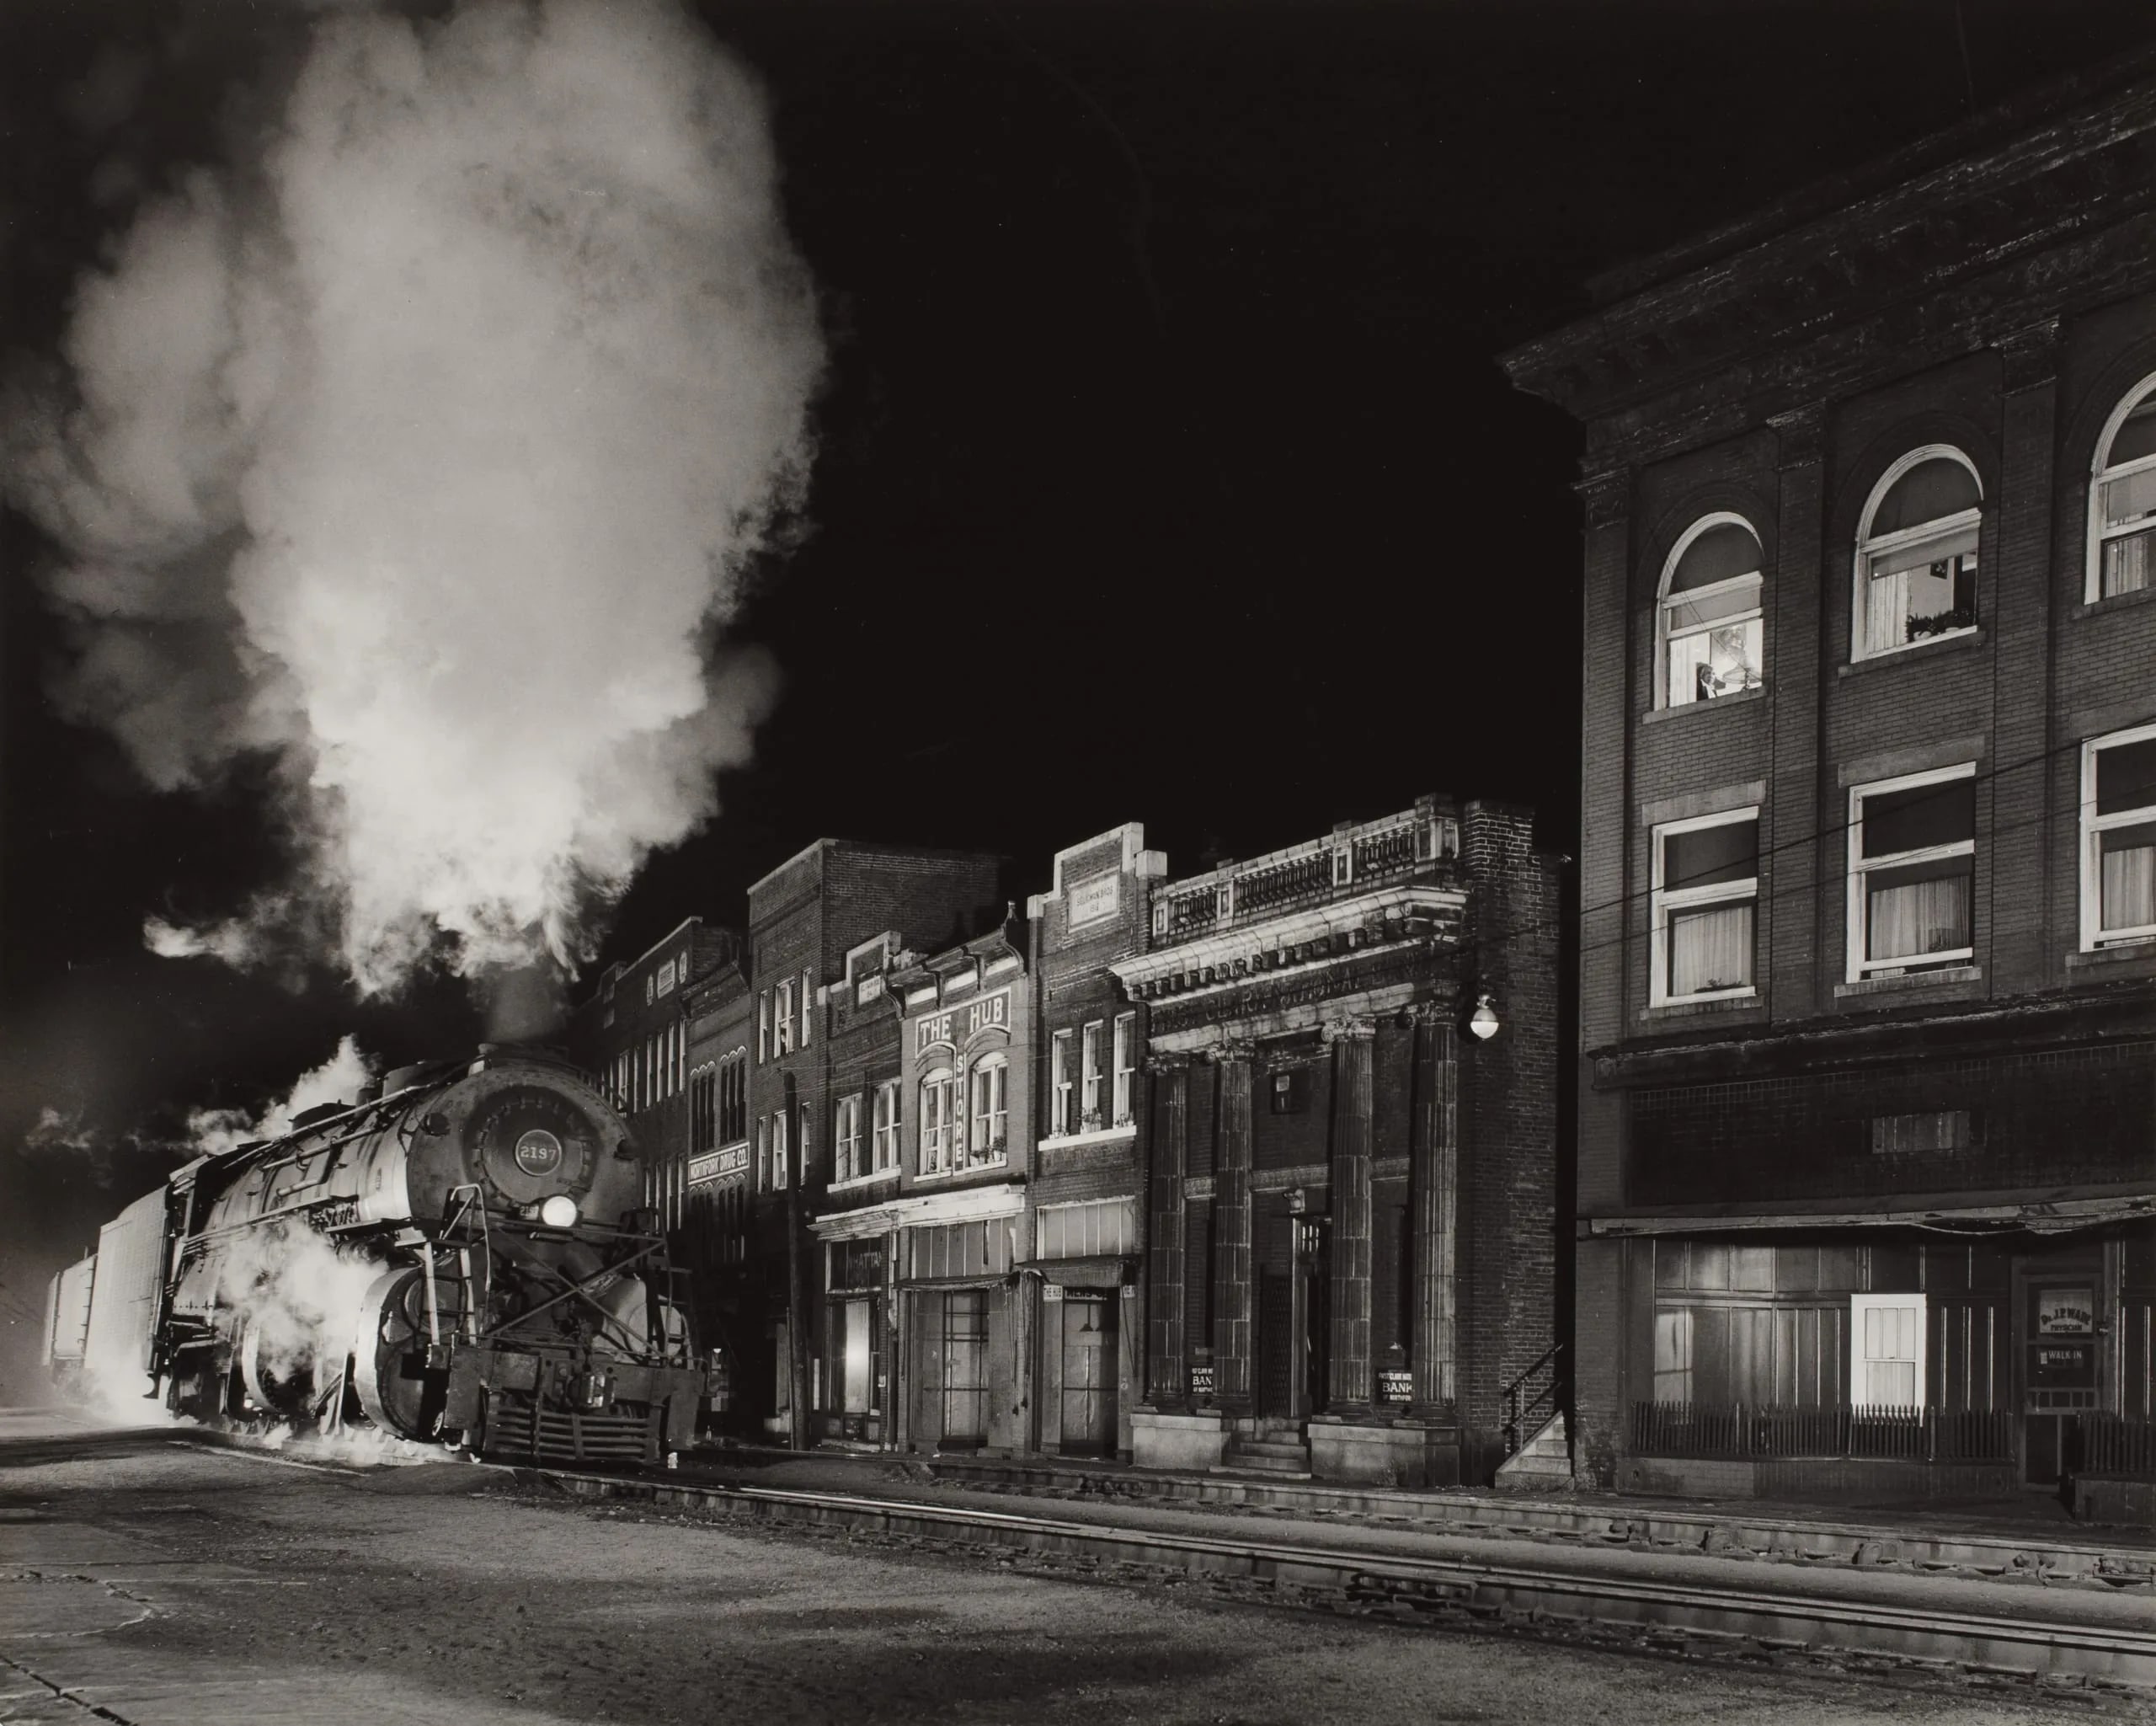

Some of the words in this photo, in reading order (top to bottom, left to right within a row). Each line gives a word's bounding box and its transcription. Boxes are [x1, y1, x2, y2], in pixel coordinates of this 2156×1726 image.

[920, 1014, 952, 1045] THE
[969, 997, 1003, 1034] HUB
[955, 1054, 964, 1162] STORE
[520, 1145, 557, 1162] 2197
[690, 1157, 719, 1180] NORTHFORK
[720, 1151, 736, 1172] DRUG
[737, 1148, 748, 1167] CO.
[2048, 1349, 2071, 1360] WALK
[2073, 1349, 2083, 1360] IN
[1382, 1381, 1412, 1393] BANK
